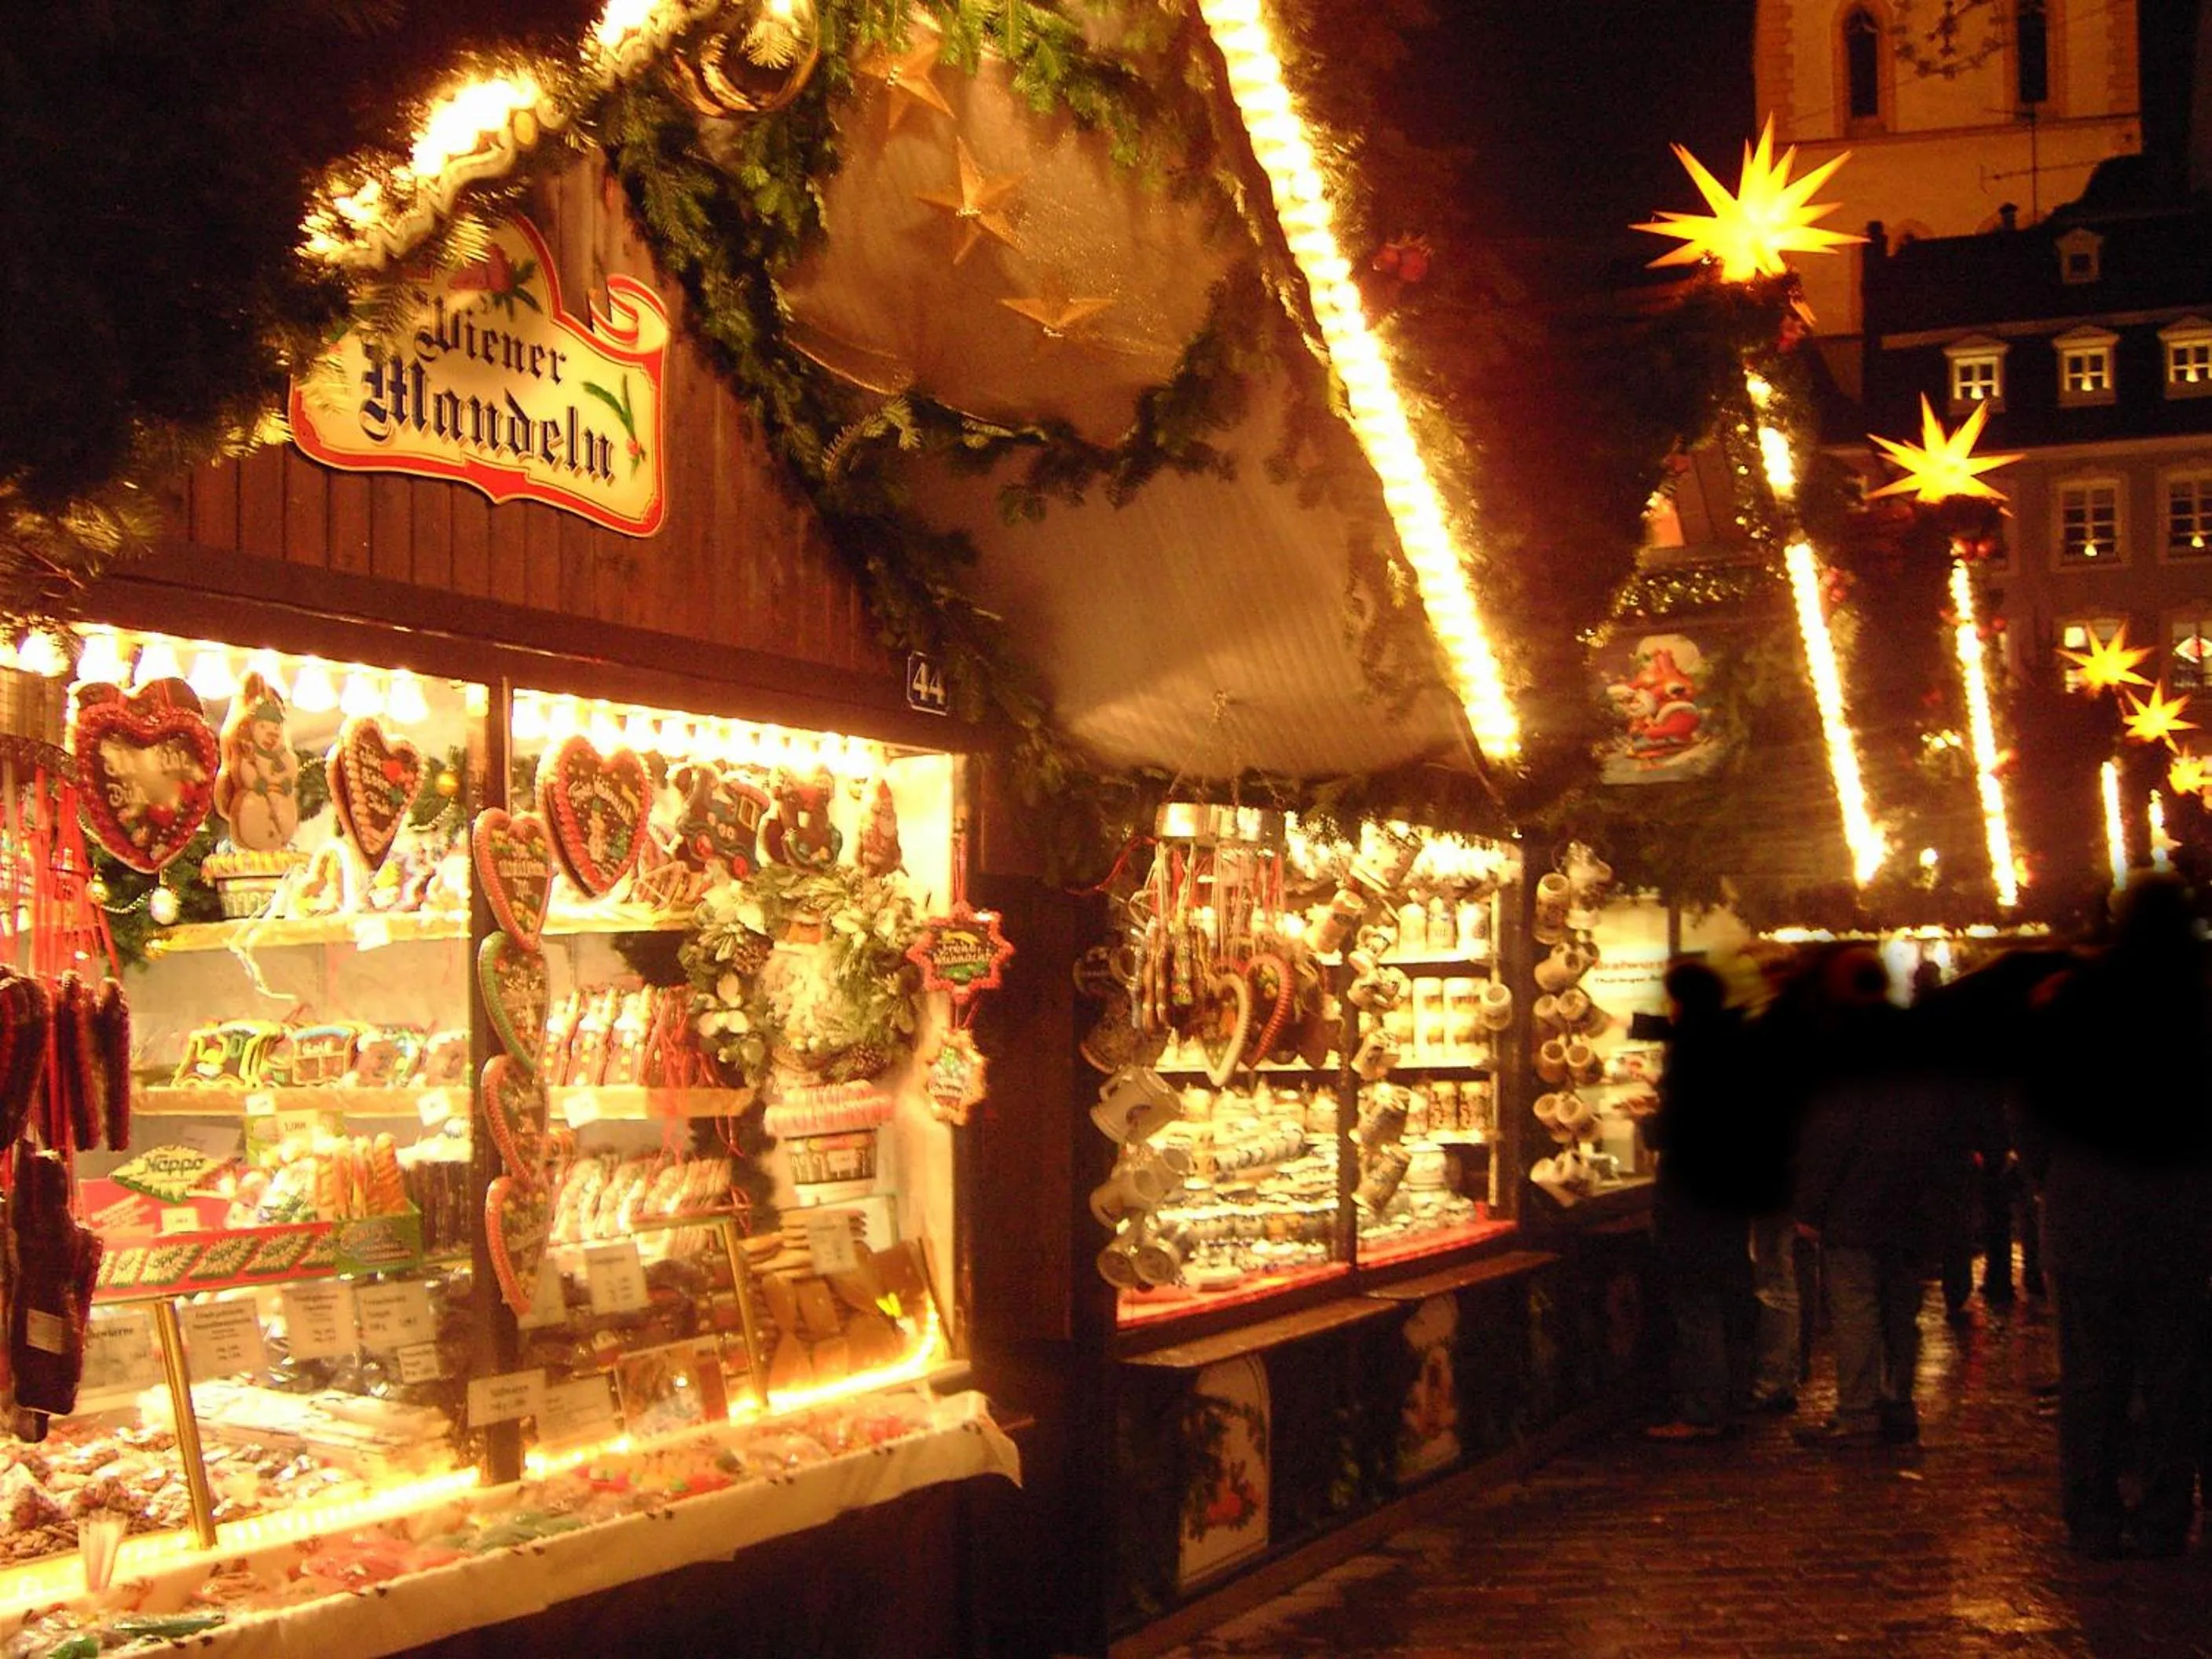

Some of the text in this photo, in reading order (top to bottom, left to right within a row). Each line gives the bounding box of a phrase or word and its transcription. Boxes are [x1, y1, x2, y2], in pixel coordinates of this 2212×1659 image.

[415, 295, 567, 385] Wiener
[359, 343, 617, 480] Mandeln
[912, 661, 946, 705] 44
[145, 1155, 206, 1177] Nappo
